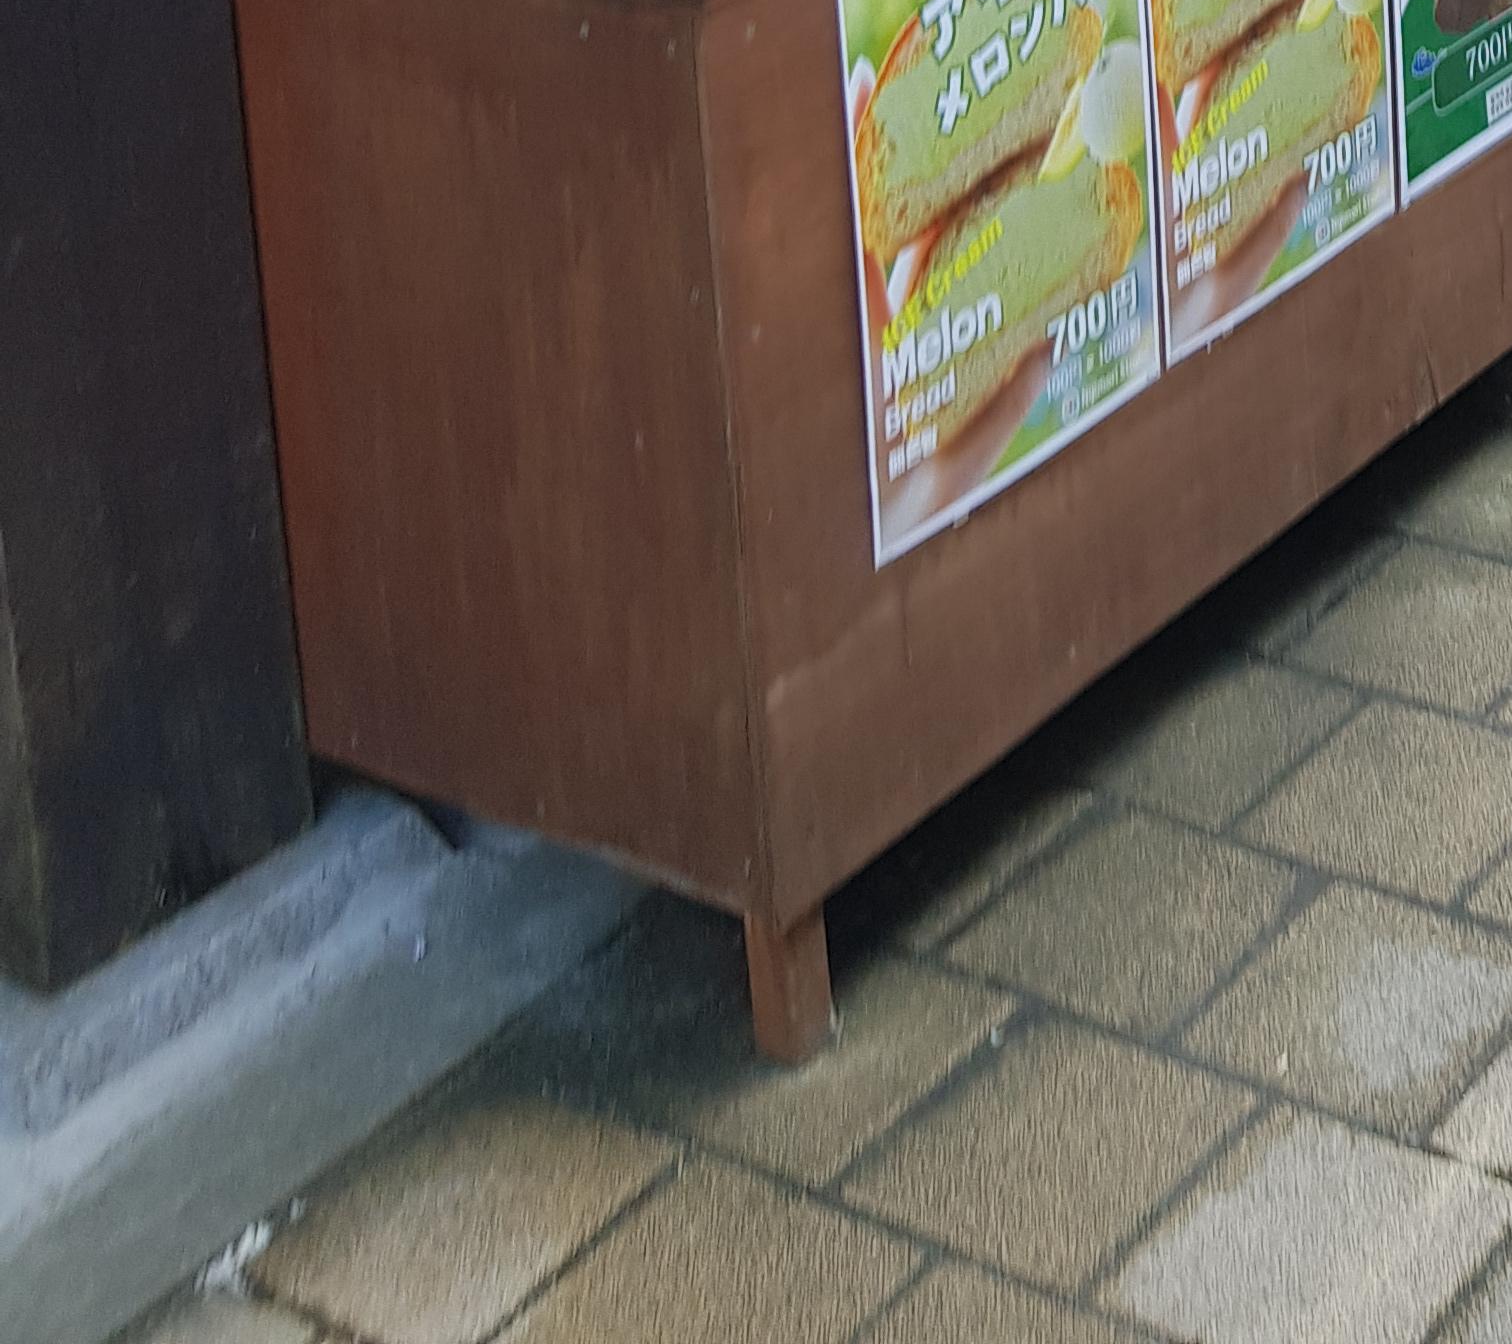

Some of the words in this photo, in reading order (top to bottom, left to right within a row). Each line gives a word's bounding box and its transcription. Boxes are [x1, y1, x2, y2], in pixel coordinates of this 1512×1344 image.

[1172, 125, 1271, 219] Melon
[1302, 113, 1379, 197] 700円
[1174, 185, 1232, 256] Bread
[882, 291, 1005, 401] Melon
[1045, 266, 1140, 369] 700円
[885, 362, 958, 443] Bread
